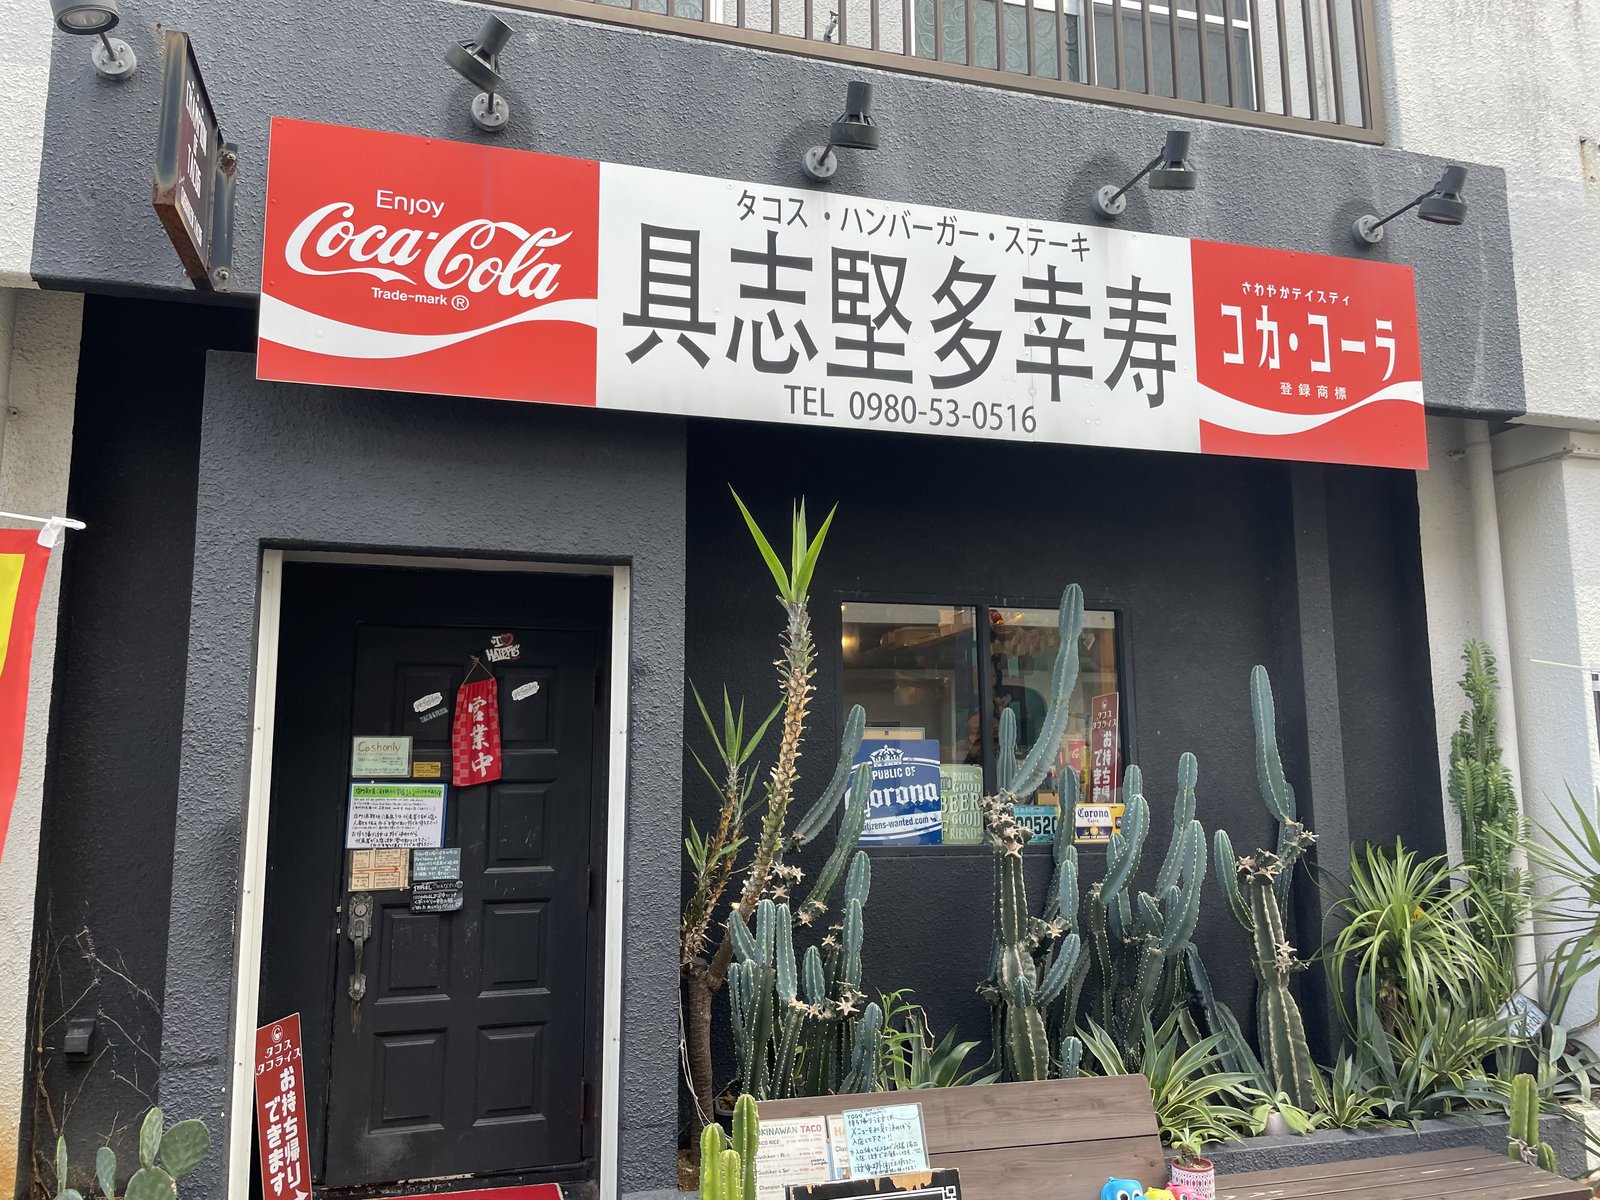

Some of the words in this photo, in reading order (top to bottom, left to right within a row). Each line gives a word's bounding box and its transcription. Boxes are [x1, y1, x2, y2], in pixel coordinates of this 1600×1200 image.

[376, 189, 445, 218] Enjoy
[285, 201, 574, 300] Coca-Cola
[371, 287, 448, 306] Trade-mark
[623, 222, 1177, 409] 具志堅多幸寿
[1221, 302, 1396, 382] コカ・コーラ
[1280, 381, 1347, 400] 登録商標
[784, 385, 834, 418] TEL
[850, 391, 1037, 433] 0980-53-0516
[467, 696, 494, 778] 営業中
[873, 768, 903, 780] PUBLIC
[905, 766, 916, 776] OF
[952, 772, 973, 781] DRINK
[952, 783, 981, 793] GOOD
[941, 793, 981, 813] BEER
[863, 816, 929, 831] itizens-wanted.com
[952, 812, 981, 826] GOOD
[1078, 808, 1109, 819] Corona
[264, 1039, 292, 1059] タコス
[256, 1047, 302, 1076] タコライス
[280, 1065, 301, 1190] お持ち帰り
[800, 1124, 822, 1133] TACO
[265, 1095, 285, 1197] できます
